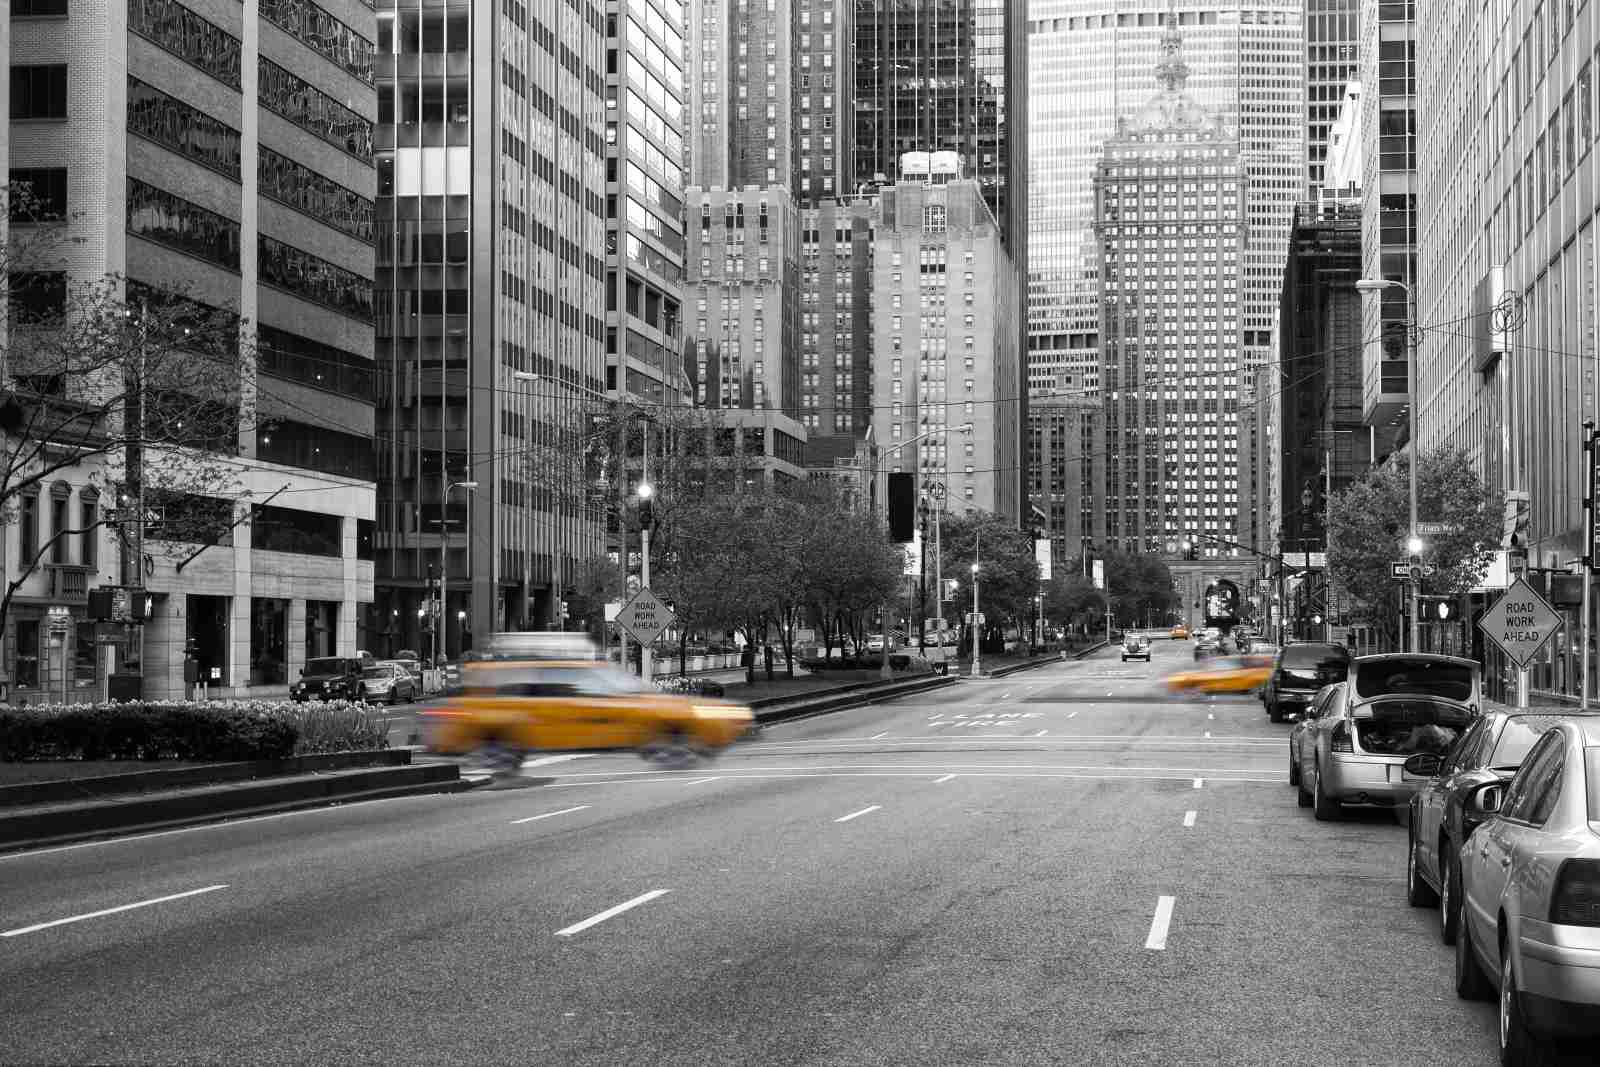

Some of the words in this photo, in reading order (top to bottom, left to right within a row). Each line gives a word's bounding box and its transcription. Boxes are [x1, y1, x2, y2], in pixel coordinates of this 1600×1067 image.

[634, 601, 656, 610] ROAD
[1505, 602, 1535, 613] ROAD
[633, 612, 656, 620] WORK
[632, 622, 660, 630] AHEAD
[1505, 616, 1536, 627] WORK
[1503, 631, 1539, 642] AHEAD
